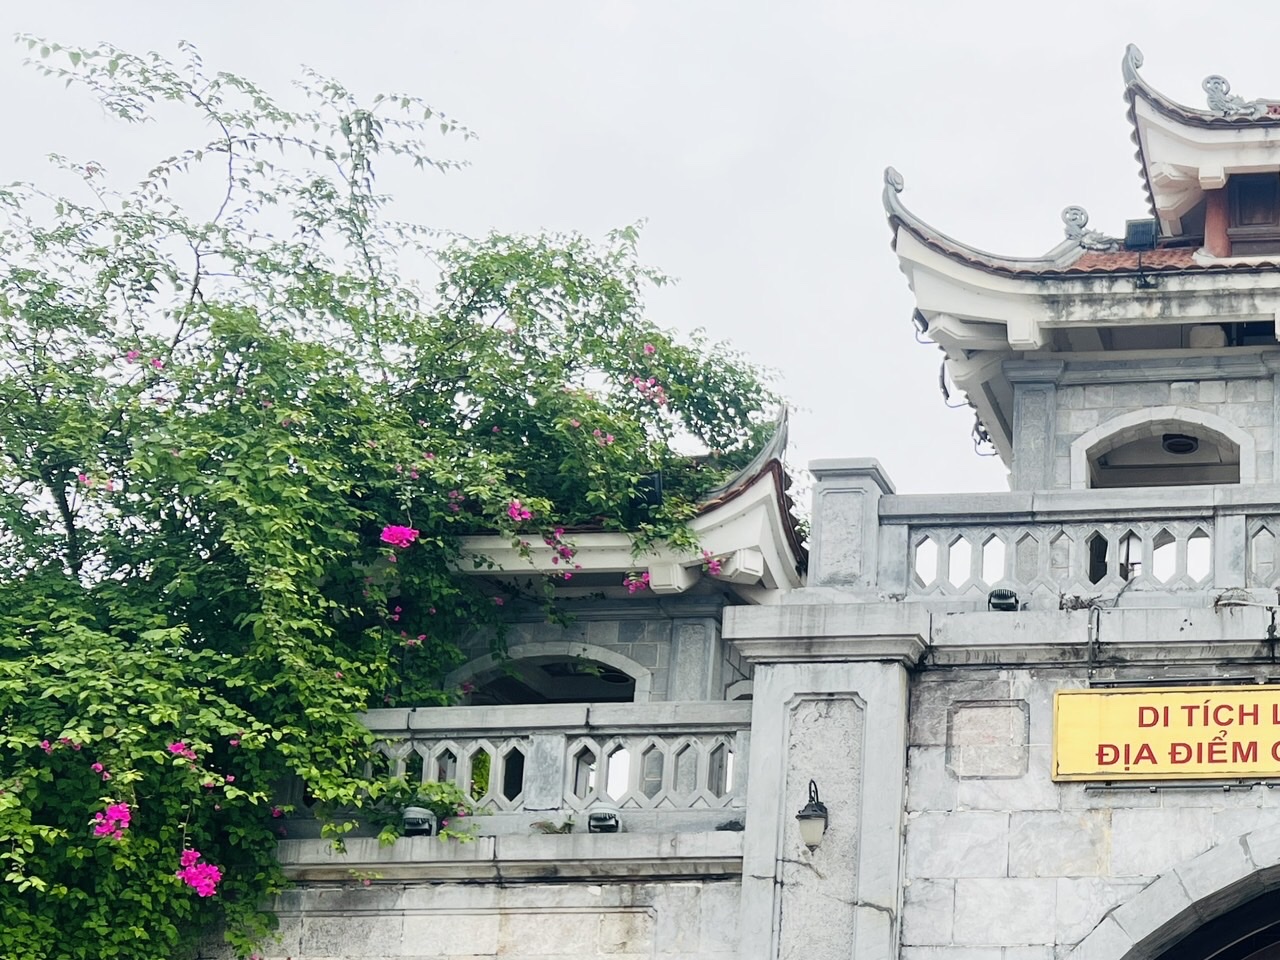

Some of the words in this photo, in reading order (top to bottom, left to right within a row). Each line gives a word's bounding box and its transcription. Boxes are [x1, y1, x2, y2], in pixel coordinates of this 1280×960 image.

[1138, 705, 1169, 728] DI
[1181, 699, 1259, 728] TÍCH
[1095, 742, 1158, 771] ĐỊA
[1168, 730, 1258, 765] ĐIỂM
